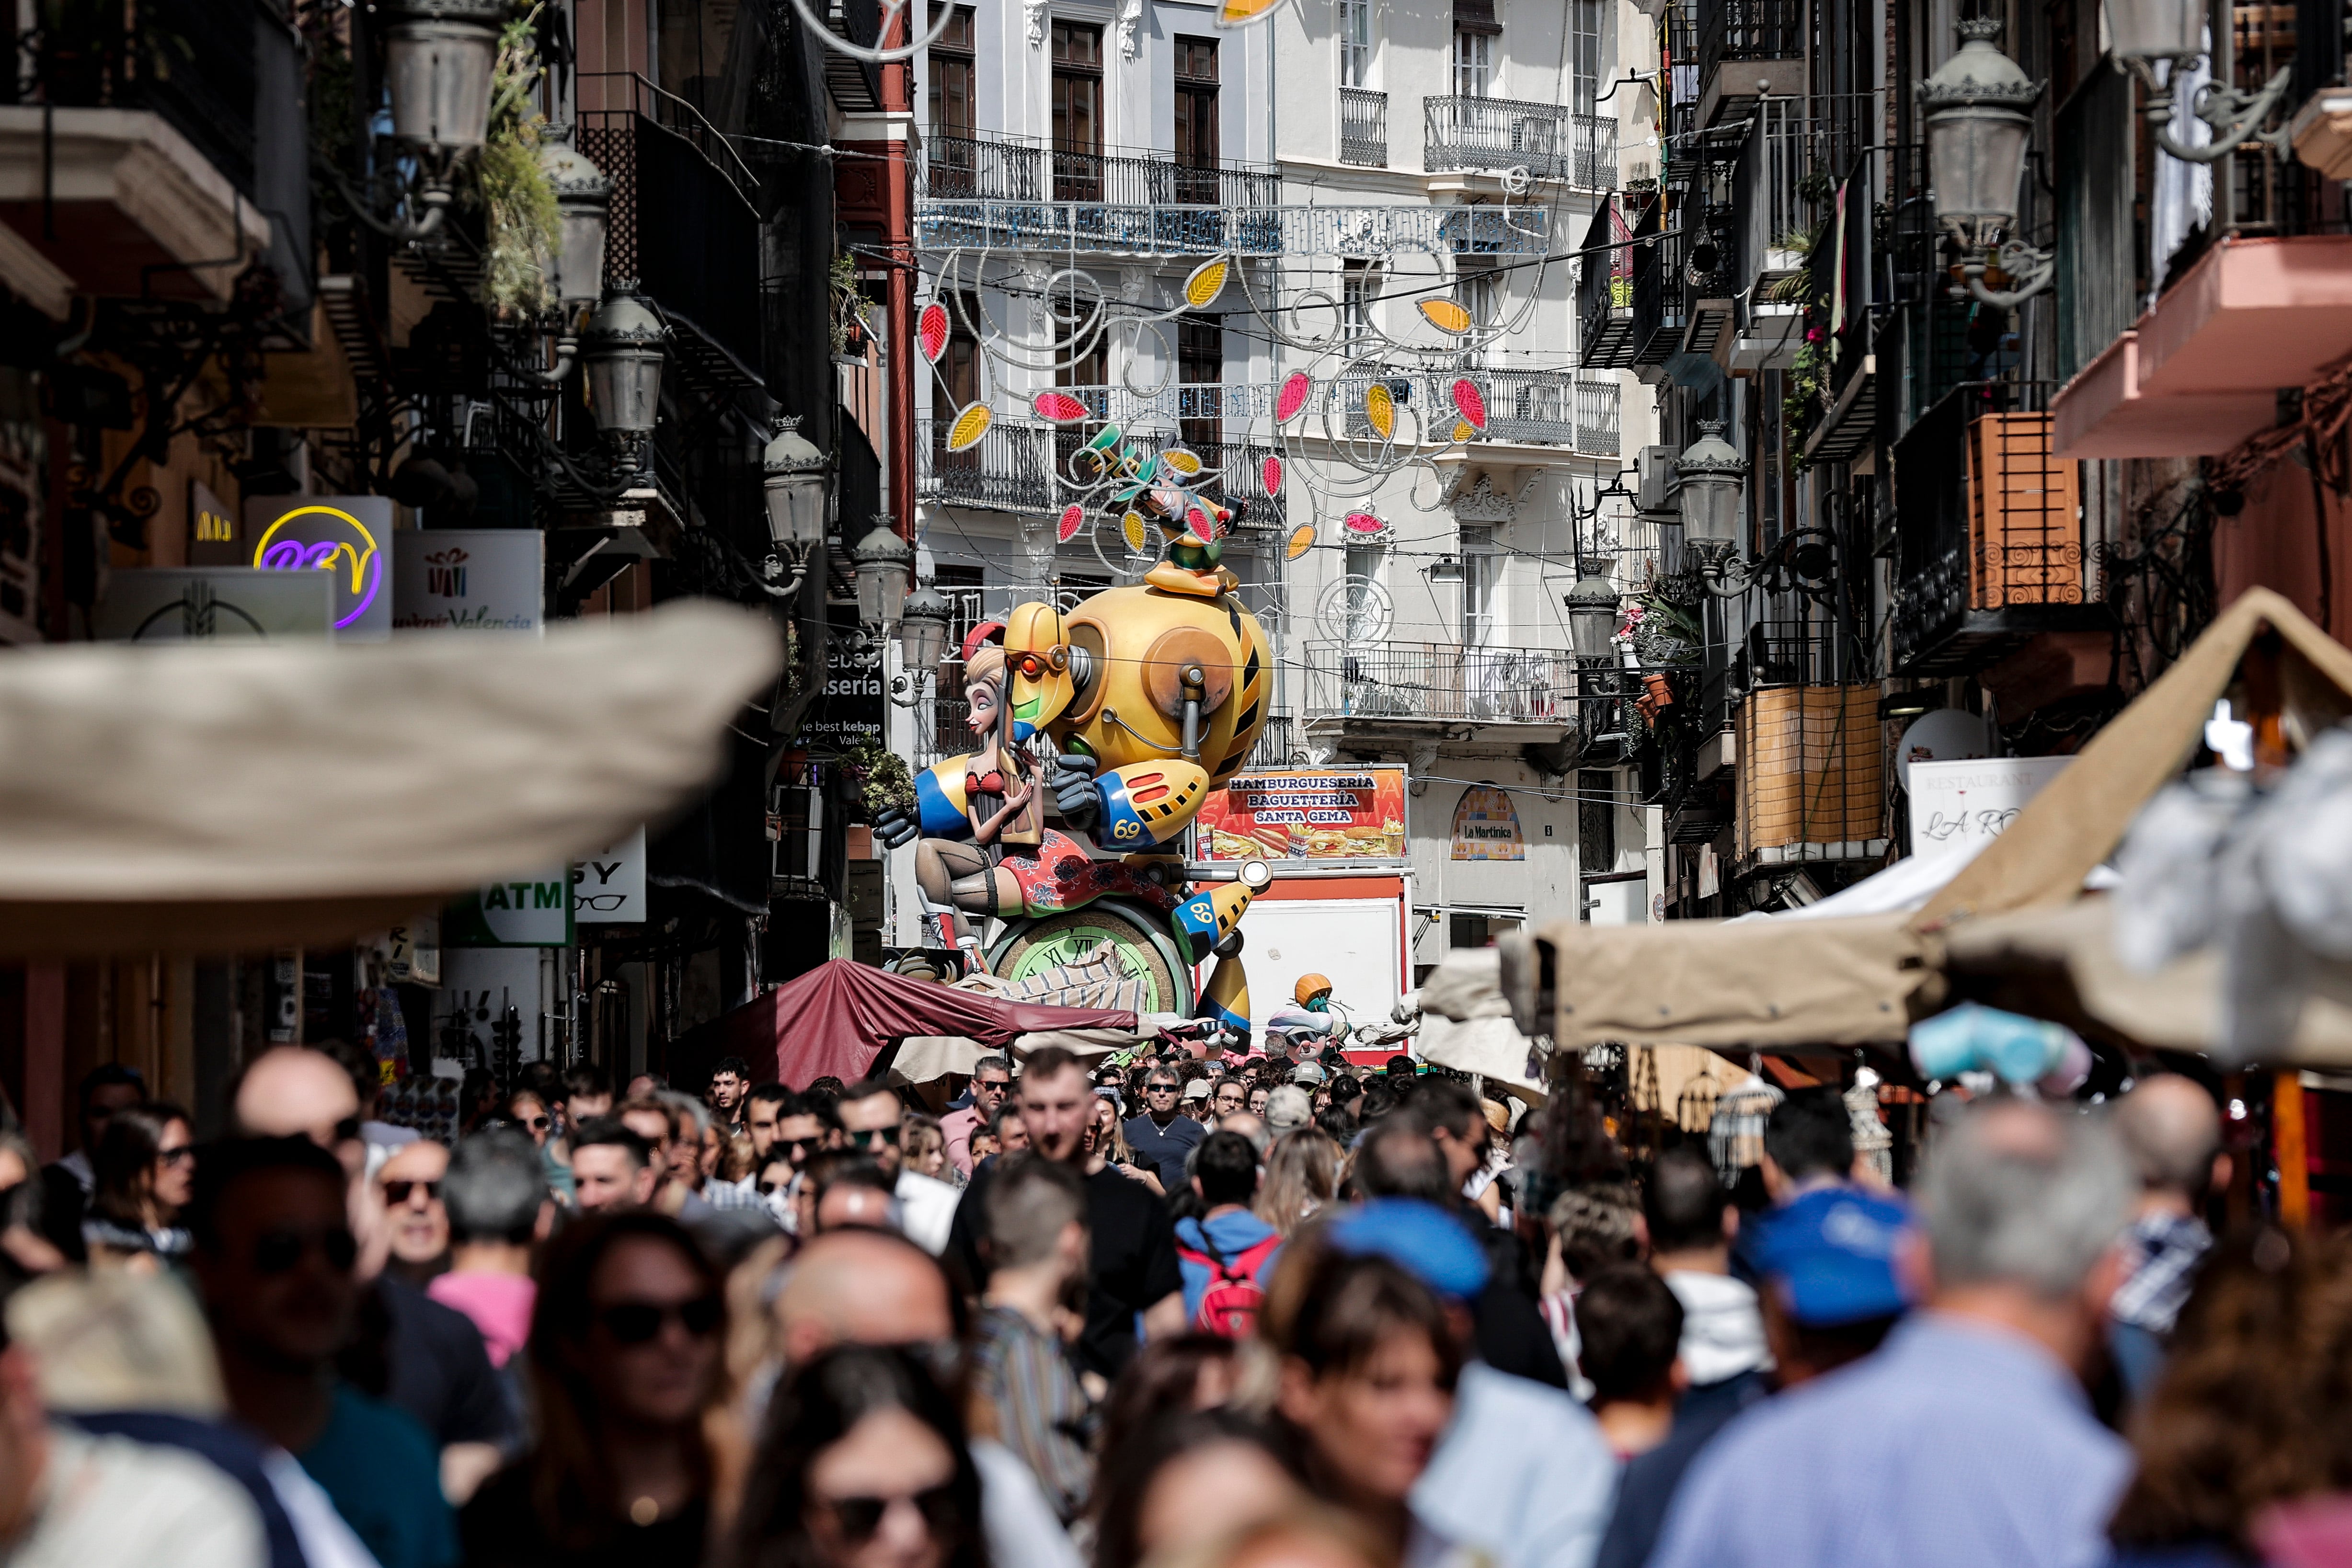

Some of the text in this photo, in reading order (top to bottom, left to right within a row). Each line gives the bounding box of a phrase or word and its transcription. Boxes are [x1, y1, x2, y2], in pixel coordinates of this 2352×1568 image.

[816, 721, 839, 731] best
[843, 721, 880, 734] kebap
[1229, 773, 1376, 790] HAMBURGUESERÍA
[1927, 773, 2033, 790] RESTAURANT
[1248, 791, 1357, 807] BAGUETTERÍA
[1255, 810, 1352, 824] SANTA GEMA
[1114, 819, 1140, 839] 69
[1464, 825, 1512, 838] La Martinica
[1547, 826, 1551, 835] 5
[1922, 811, 1971, 841] LA
[485, 882, 562, 910] ATM
[1190, 902, 1213, 924] 69
[1043, 946, 1066, 967] XI
[1073, 939, 1094, 960] XII
